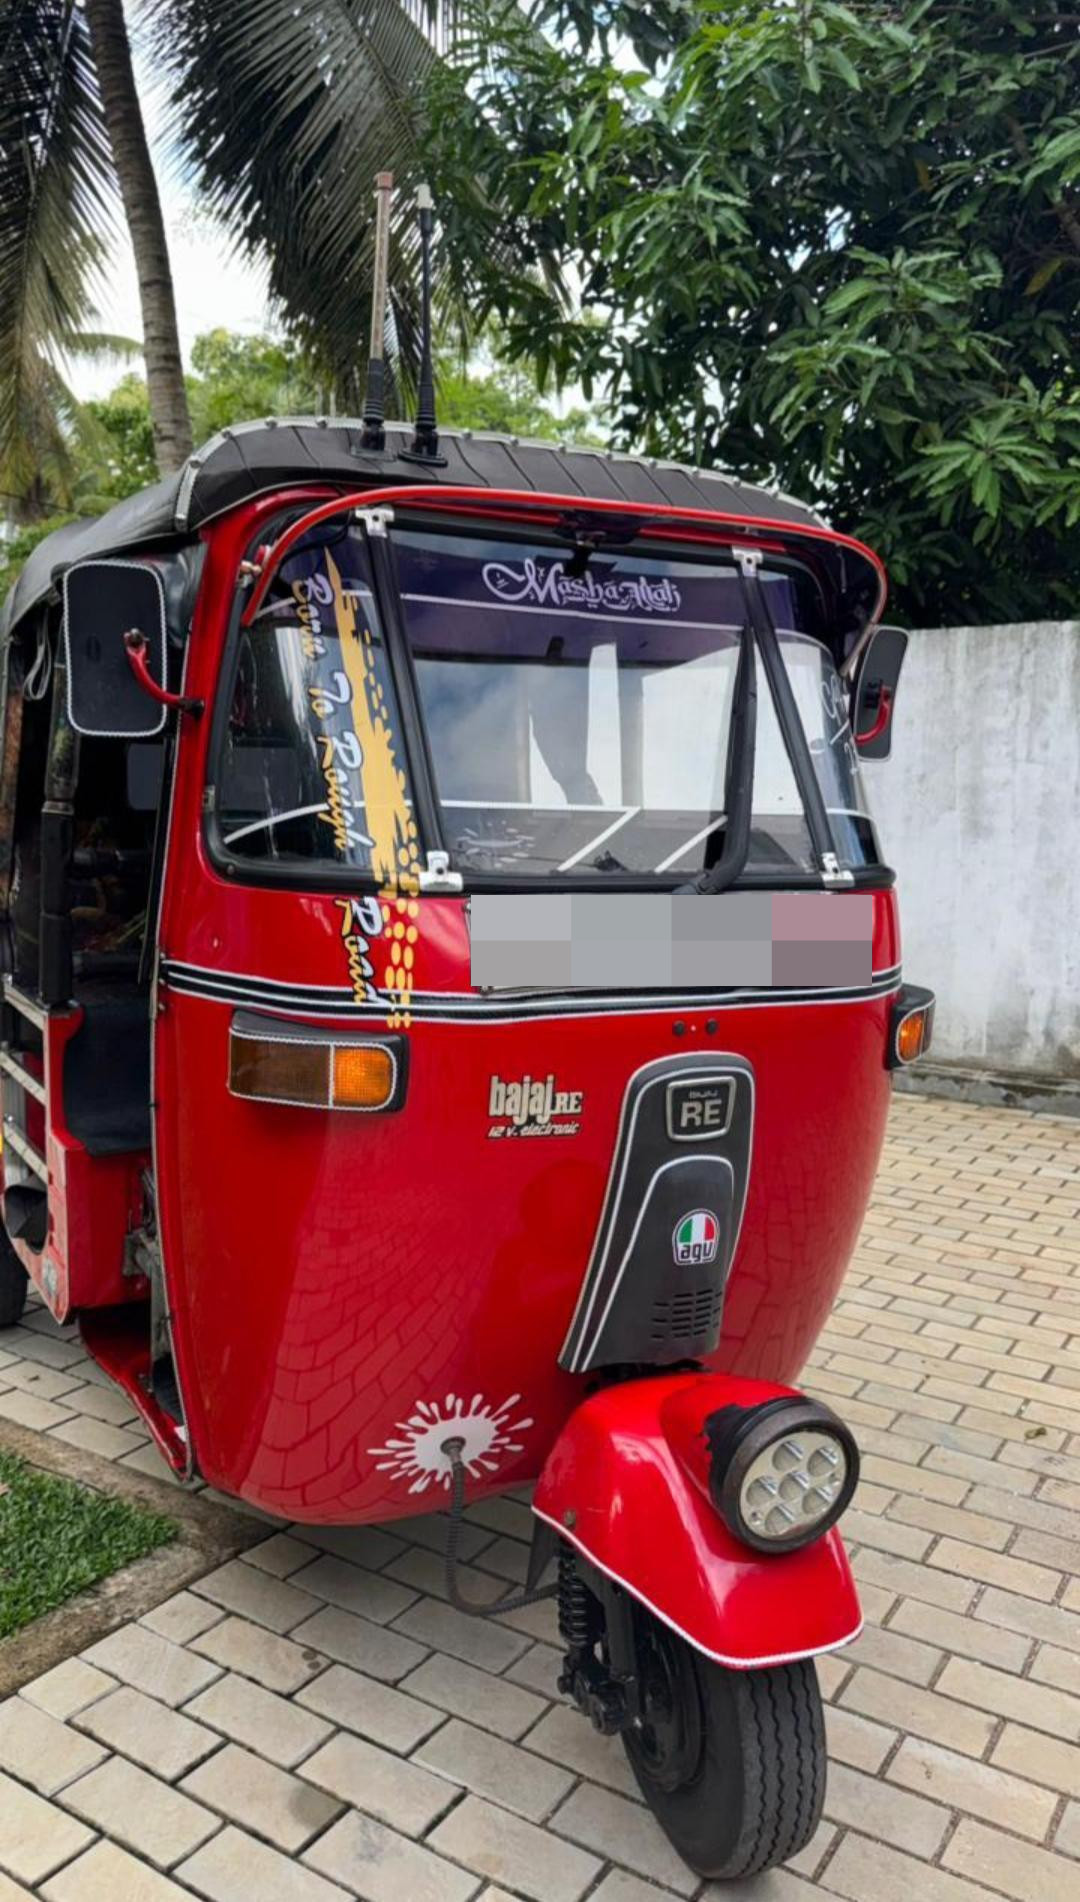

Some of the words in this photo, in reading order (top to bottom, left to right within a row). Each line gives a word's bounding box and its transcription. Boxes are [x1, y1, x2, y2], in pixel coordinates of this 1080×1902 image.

[308, 671, 351, 720] To
[317, 731, 375, 851] Rough
[334, 896, 396, 1012] Road
[488, 1074, 554, 1125] bajaj
[553, 1091, 583, 1115] RE
[680, 1099, 722, 1128] RE
